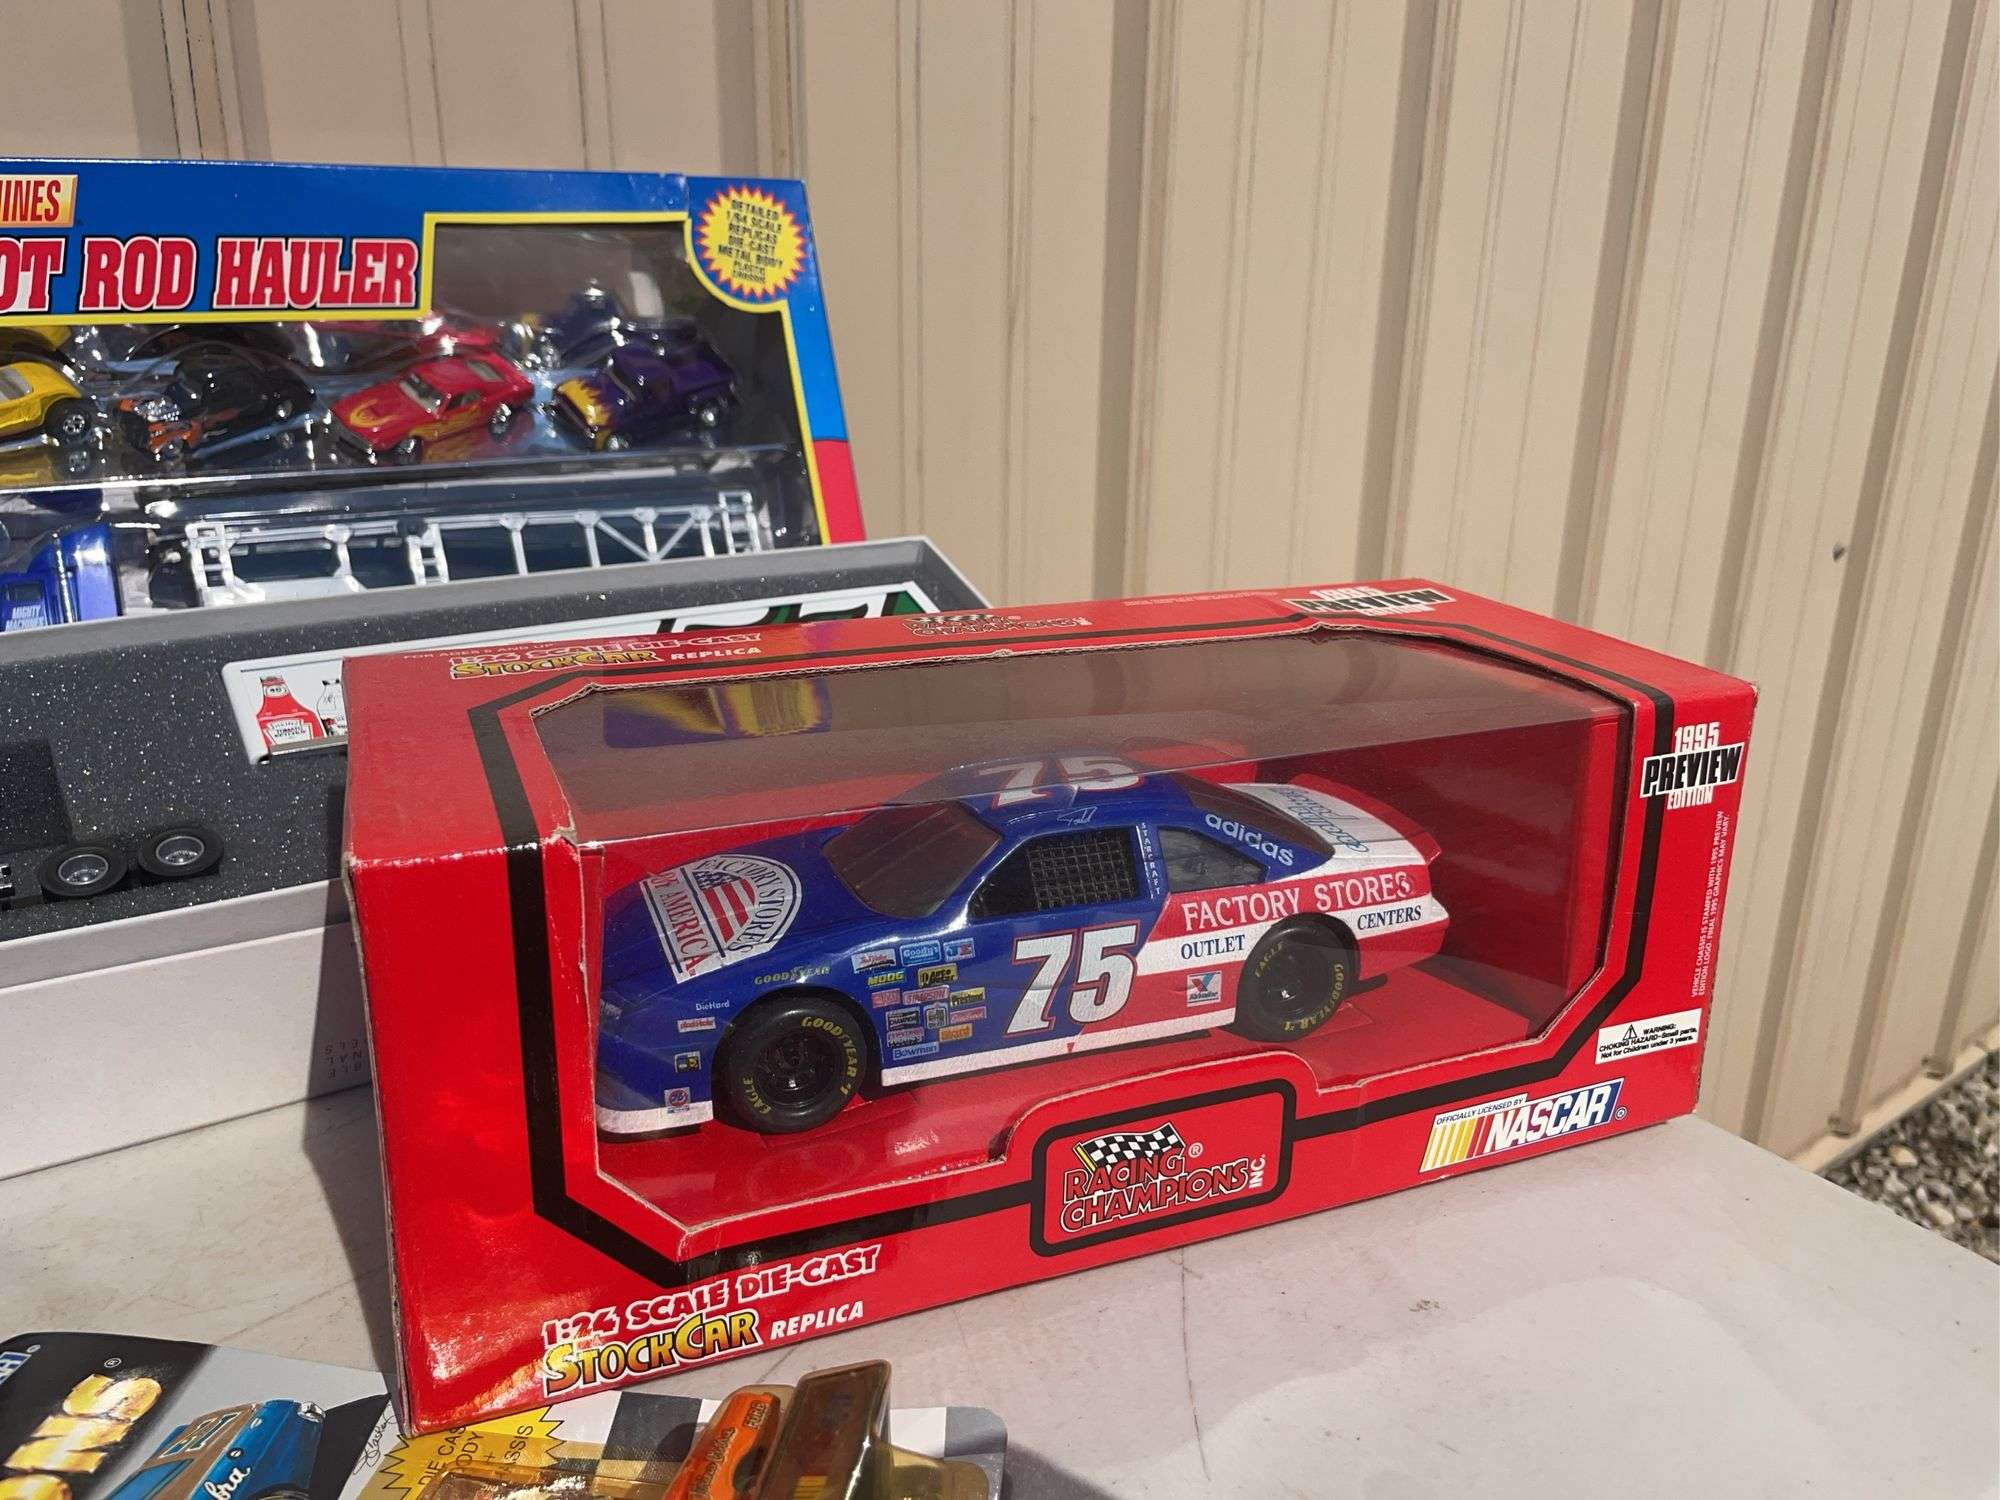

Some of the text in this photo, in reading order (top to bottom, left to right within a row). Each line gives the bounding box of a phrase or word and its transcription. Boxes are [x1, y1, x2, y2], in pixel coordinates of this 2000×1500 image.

[79, 236, 196, 311] ROD
[213, 237, 418, 308] HAULER
[1290, 590, 1451, 610] PREVIEW
[629, 633, 761, 651] DIE-CAST
[671, 647, 762, 660] REPLICA
[1674, 722, 1720, 753] 1995
[978, 755, 1145, 810] 75
[1642, 744, 1743, 796] PREVIEW
[1667, 785, 1713, 810] EDITION
[1205, 813, 1294, 866] adidas
[1713, 811, 1725, 845] PREVIEW
[1707, 866, 1716, 887] WITH
[695, 859, 785, 953] FACTORY STORES
[1181, 871, 1411, 931] FACTORY STORES
[1702, 889, 1713, 925] STAMPED
[659, 891, 712, 972] AMERICA
[1181, 905, 1422, 960] OUTLET CENTERS
[754, 966, 831, 985] GOODYEAR
[1002, 919, 1140, 1039] 75
[1254, 941, 1284, 978] EAGLE
[1300, 963, 1344, 1030] GOODYEAR
[1691, 967, 1701, 997] VEHICLE
[695, 1000, 730, 1011] DieHard
[801, 1016, 858, 1078] GOODYEAR
[1599, 1040, 1629, 1052] CHOKING
[1643, 1023, 1676, 1035] WARNING:
[895, 1045, 937, 1059] Bowman
[1601, 1051, 1612, 1060] Not
[1613, 1049, 1622, 1057] for
[1623, 1043, 1649, 1054] Children
[1650, 1039, 1669, 1048] under
[743, 1076, 772, 1115] EAGLE
[1436, 1097, 1525, 1126] OFFICIALLY LICENSED BY
[1483, 1084, 1612, 1154] NASCAR
[1060, 1153, 1266, 1233] CHAMPIONS INC.
[1063, 1146, 1184, 1204] RACING
[541, 1244, 882, 1345] 1:24 SCALE DIE-CAST
[770, 1300, 864, 1341] REPLICA
[418, 1426, 466, 1485] DIE CAS
[456, 1431, 484, 1467] ODY
[503, 1425, 534, 1466] SSIS
